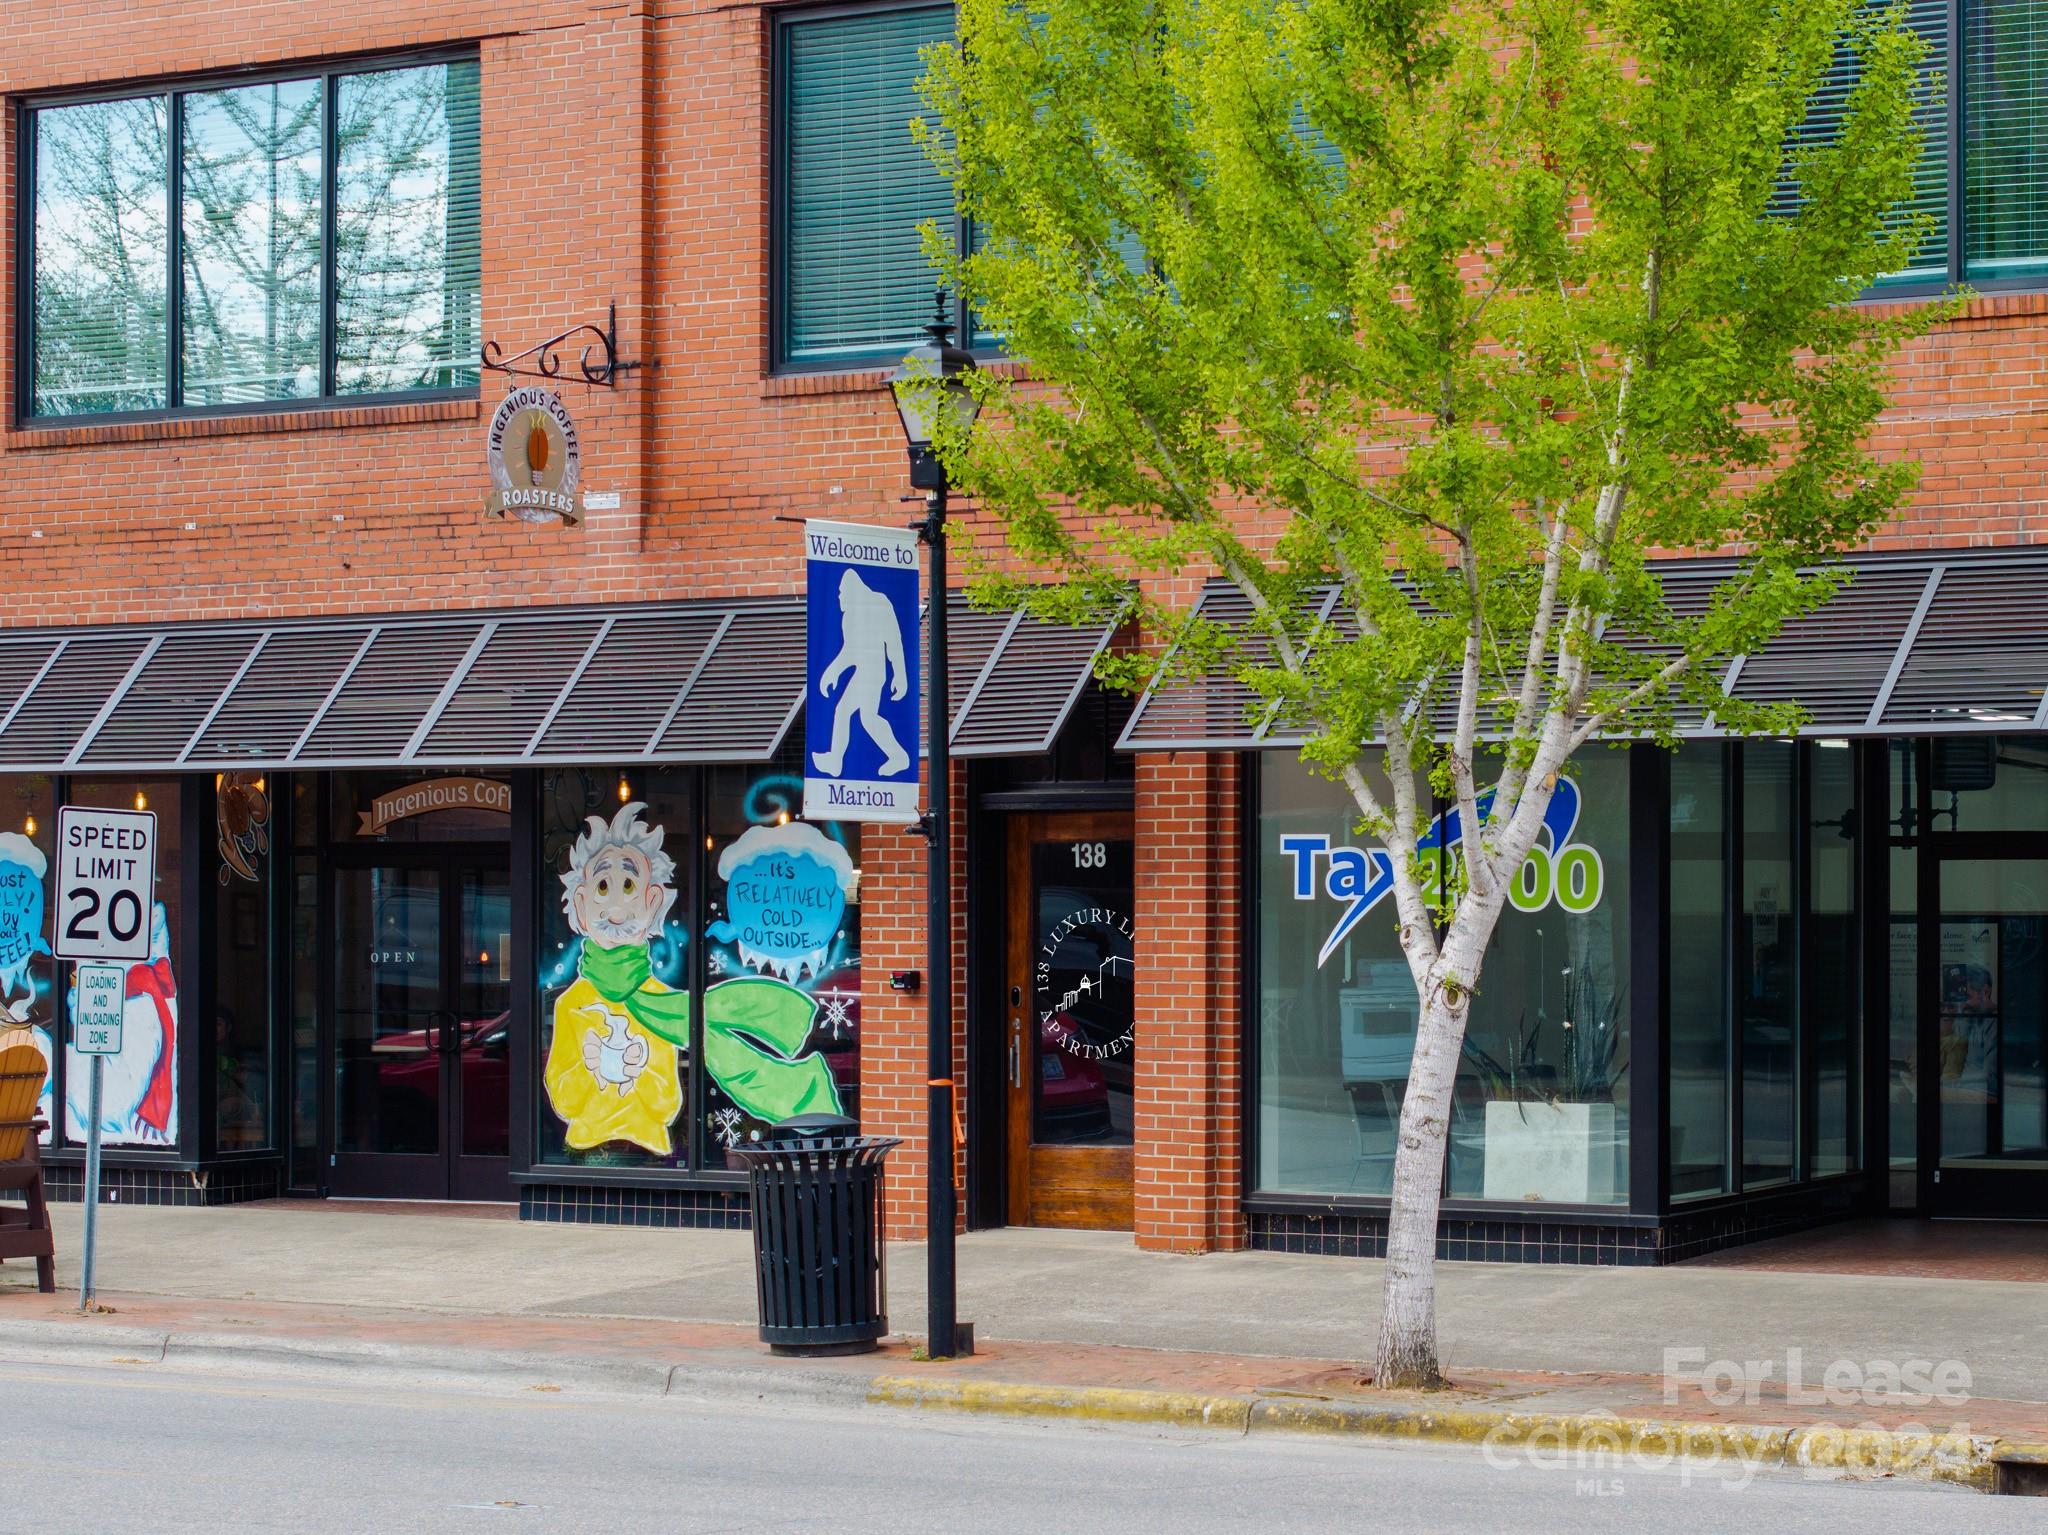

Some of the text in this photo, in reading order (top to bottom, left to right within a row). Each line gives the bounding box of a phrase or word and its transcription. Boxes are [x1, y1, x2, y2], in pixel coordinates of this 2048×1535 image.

[491, 390, 579, 460] INGENIOUS COFFEE
[502, 488, 575, 514] ROASTERS
[809, 534, 913, 565] Welcome to
[376, 784, 468, 824] Ingenious
[828, 783, 895, 808] Marion
[68, 825, 147, 851] SPEED
[75, 856, 137, 881] LIMIT
[1071, 842, 1107, 869] 138
[735, 881, 837, 912] RELATIVELY
[1279, 833, 1604, 970] Tax200
[65, 886, 142, 942] 20
[761, 908, 803, 928] COLD
[1043, 908, 1117, 957] LUXURY
[370, 951, 416, 963] OPEN
[85, 976, 117, 989] LOADING
[1037, 961, 1051, 993] 138
[93, 995, 108, 1008] AND
[80, 1012, 120, 1026] UNLOADING
[89, 1031, 108, 1044] ZONE
